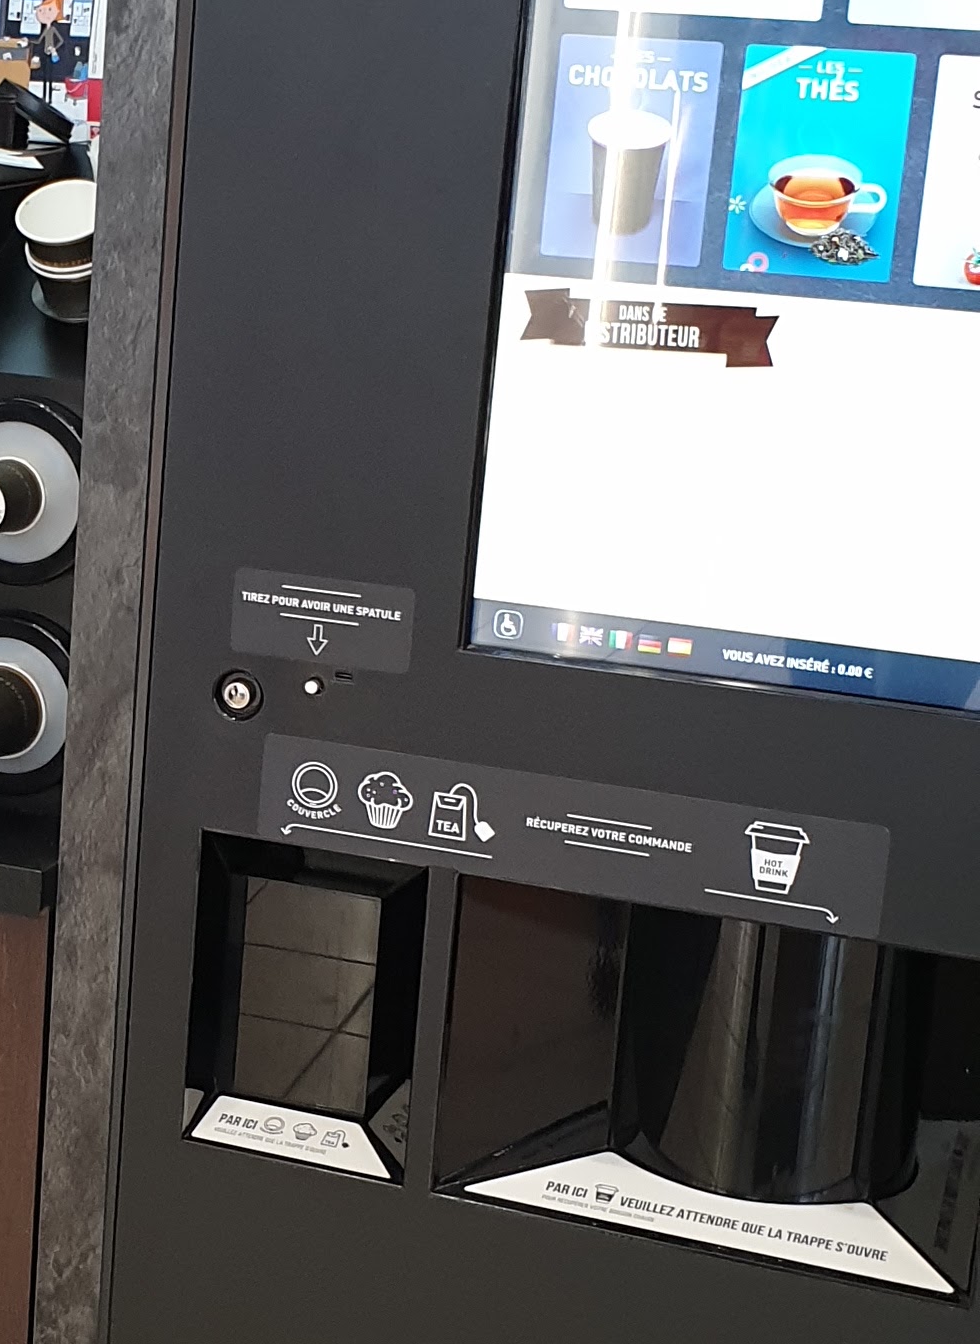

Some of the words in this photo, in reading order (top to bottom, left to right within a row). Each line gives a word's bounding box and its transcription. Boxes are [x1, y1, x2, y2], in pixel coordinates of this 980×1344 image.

[796, 68, 860, 102] THÉS
[618, 305, 650, 323] DANS
[241, 591, 270, 604] TIREZ
[272, 595, 300, 608] POUR
[301, 599, 331, 612] AVOIR
[332, 604, 354, 615] UNE
[355, 606, 401, 621] SPATULE
[722, 649, 753, 664] VOUS
[754, 653, 785, 667] AVEZ
[786, 657, 831, 674] INSÉRÉ
[837, 664, 863, 678] 0.00
[863, 667, 874, 679] €
[286, 798, 342, 819] COUVERCLE
[436, 819, 460, 834] TEA
[591, 827, 627, 843] VOTRE
[628, 833, 693, 853] COMMANDE
[759, 866, 789, 878] DRINK
[764, 858, 783, 868] HOT
[218, 1113, 242, 1127] PAR
[242, 1118, 259, 1130] ICI
[545, 1181, 570, 1195] PAR
[571, 1186, 588, 1198] ICI
[620, 1196, 675, 1217] VEUILLEZ
[676, 1209, 739, 1230] ATTENDRE
[741, 1221, 766, 1235] QUE
[767, 1227, 783, 1240] LA
[786, 1231, 833, 1250] TRAPPE
[835, 1241, 888, 1262] S'OUVRE
